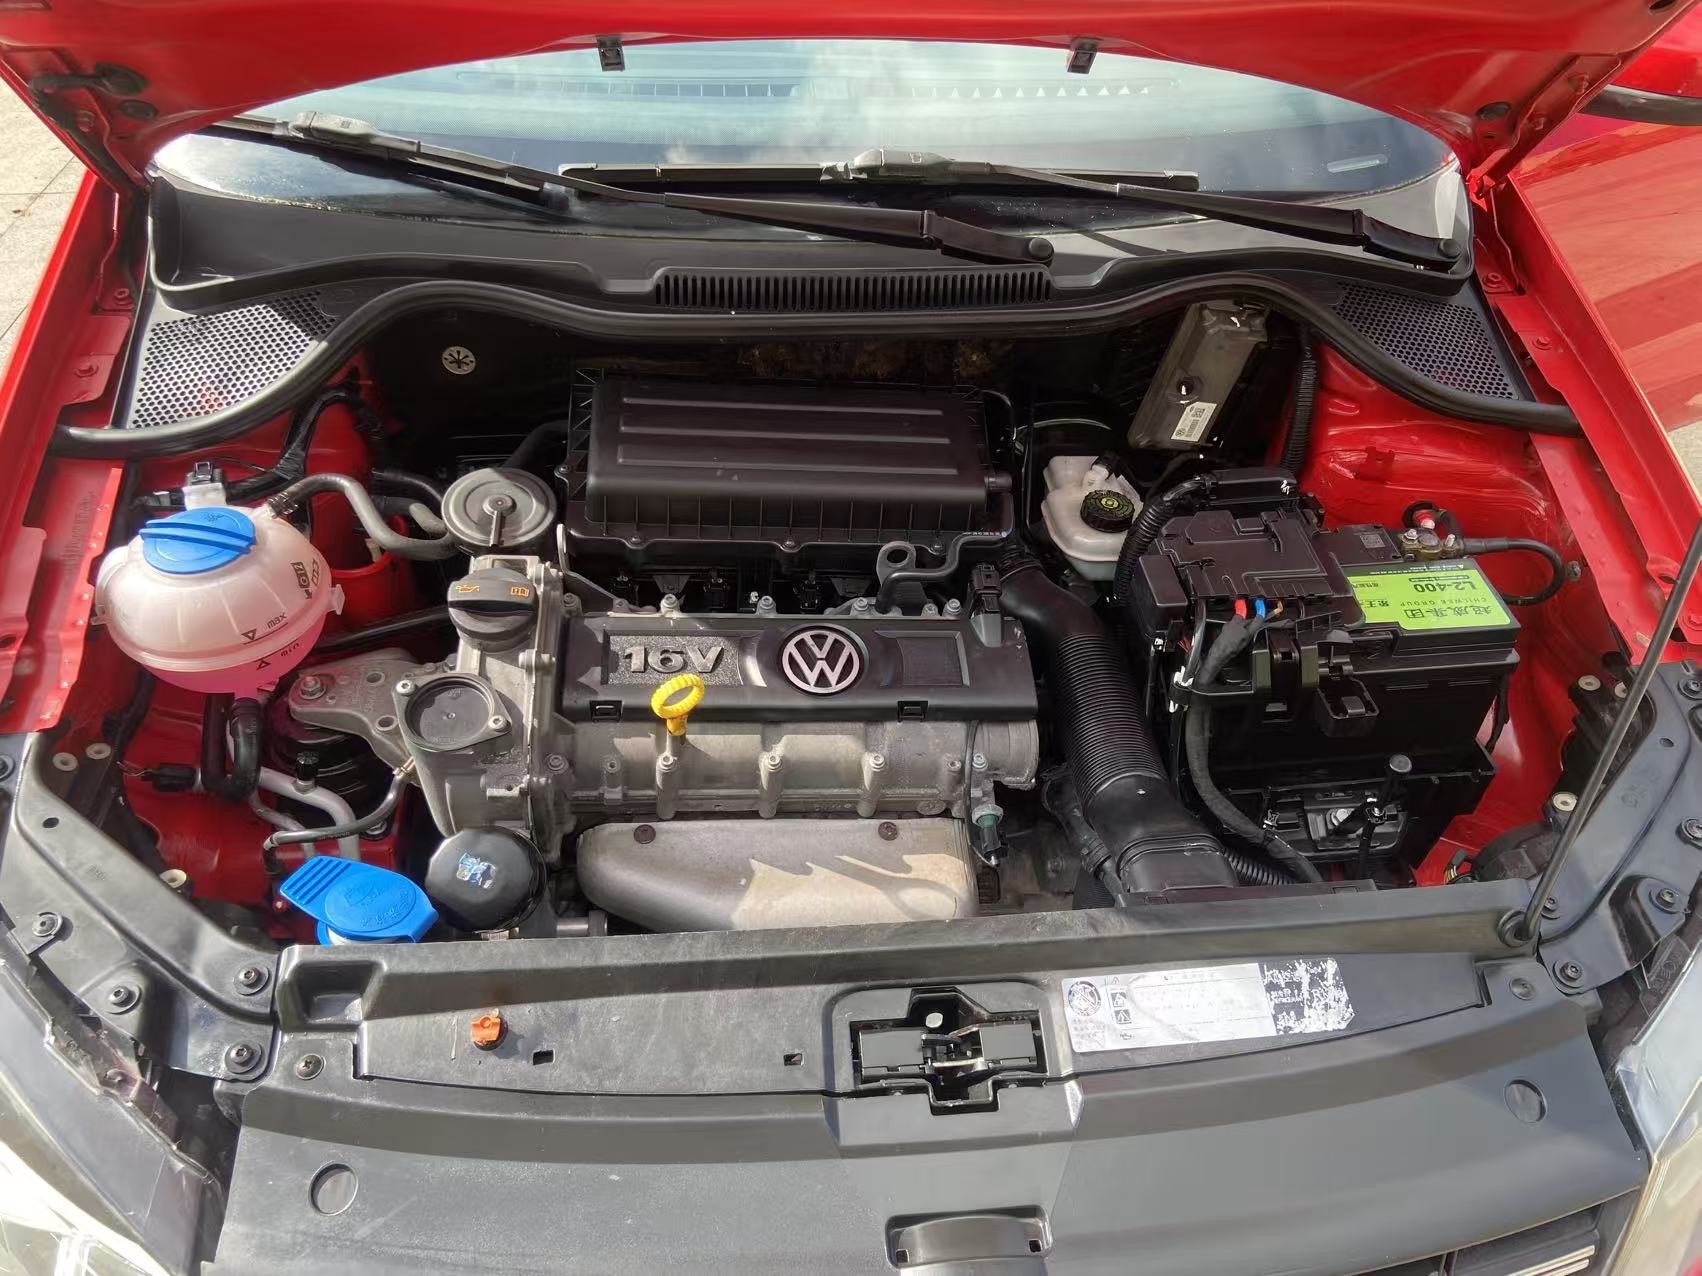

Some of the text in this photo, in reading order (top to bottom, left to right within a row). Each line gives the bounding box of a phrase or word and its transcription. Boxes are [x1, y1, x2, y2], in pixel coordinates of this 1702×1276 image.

[1413, 580, 1477, 593] L2-400
[266, 612, 288, 629] max
[624, 645, 724, 673] 16V
